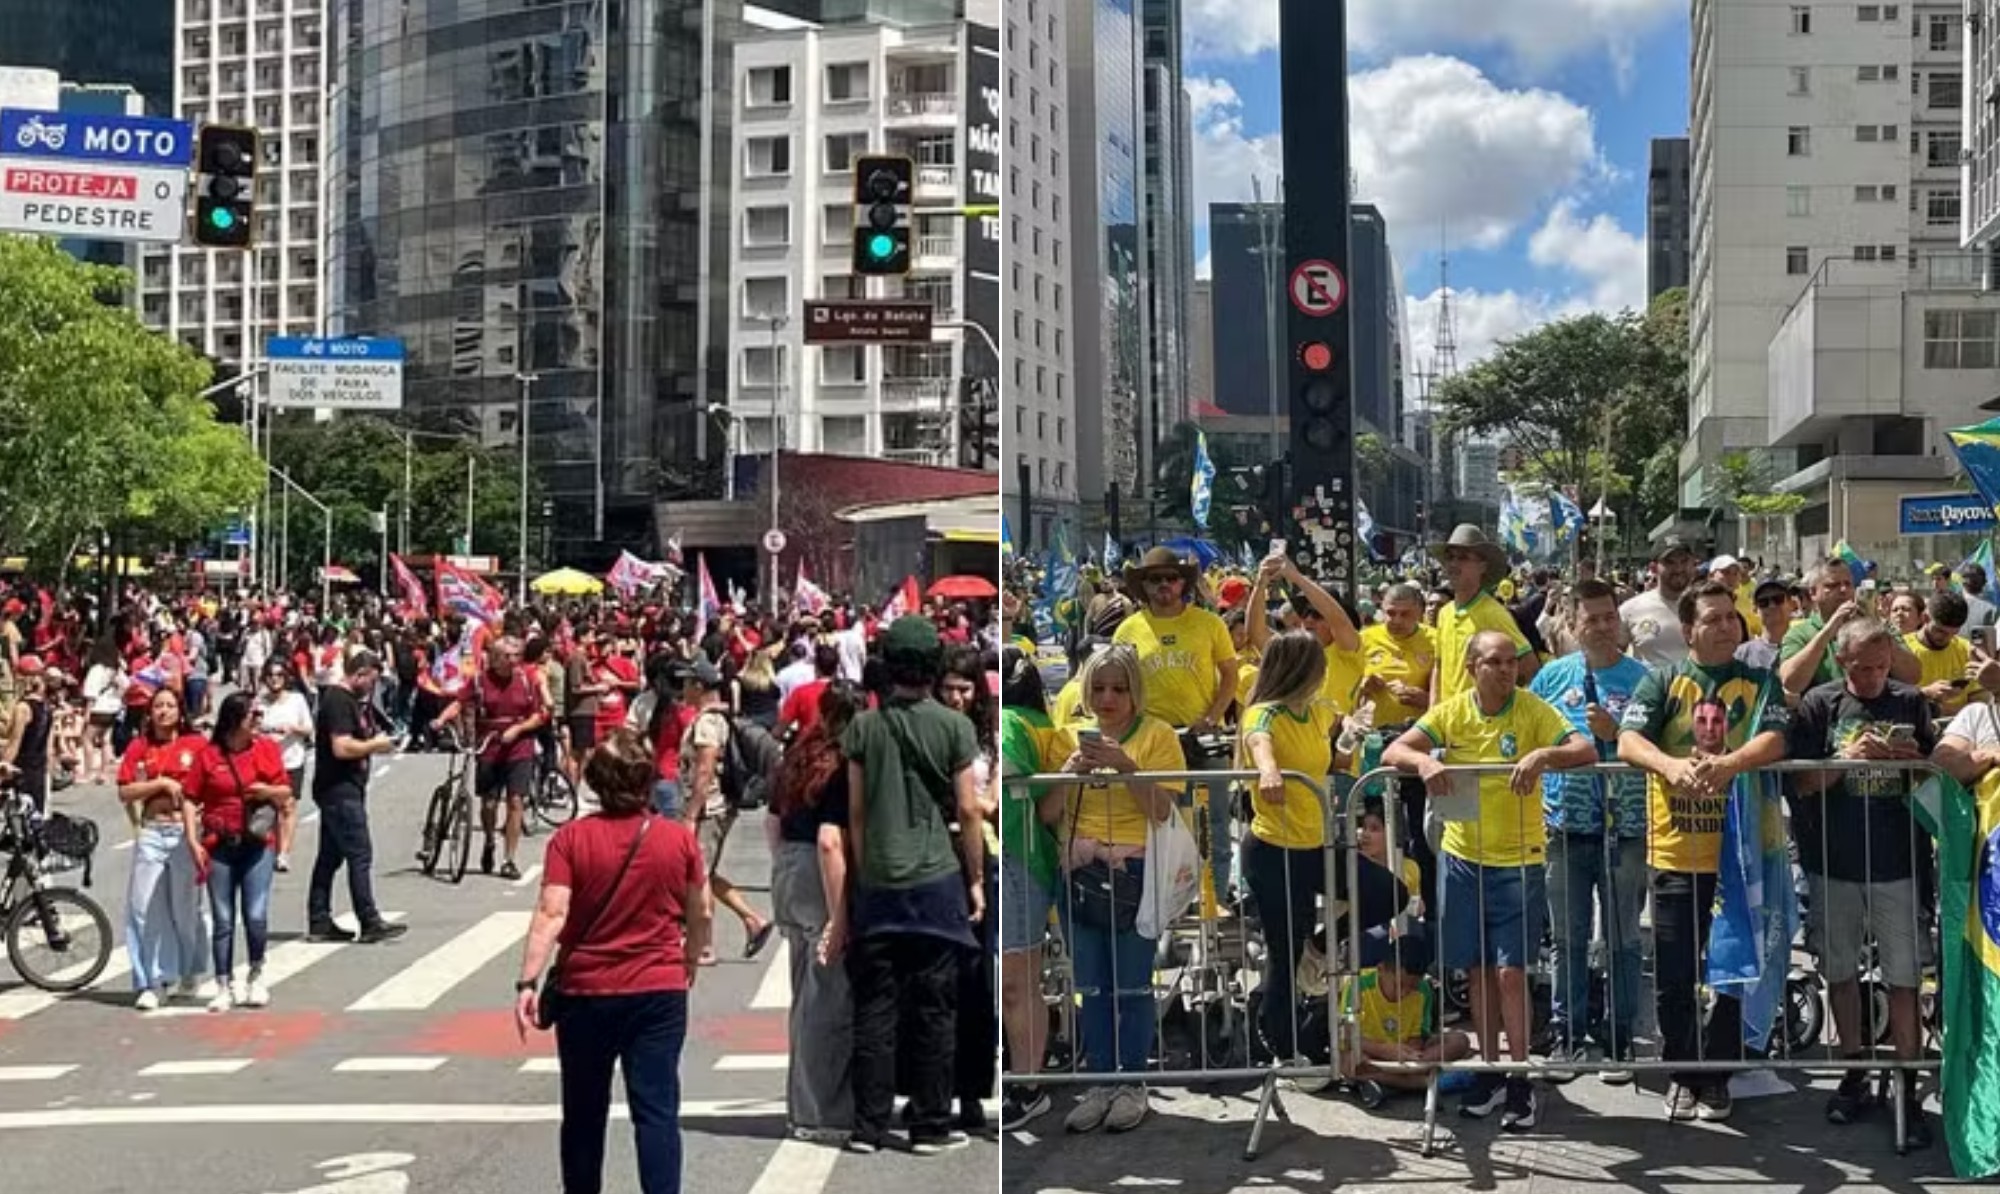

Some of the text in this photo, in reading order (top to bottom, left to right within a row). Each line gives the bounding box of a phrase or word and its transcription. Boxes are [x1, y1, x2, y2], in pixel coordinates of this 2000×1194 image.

[84, 126, 175, 156] MOTO
[11, 171, 129, 197] PROTEJA
[23, 203, 154, 231] PEDESTRE
[329, 342, 370, 355] MOTO
[274, 364, 328, 375] FACILITE
[300, 377, 371, 389] DE FAIXA
